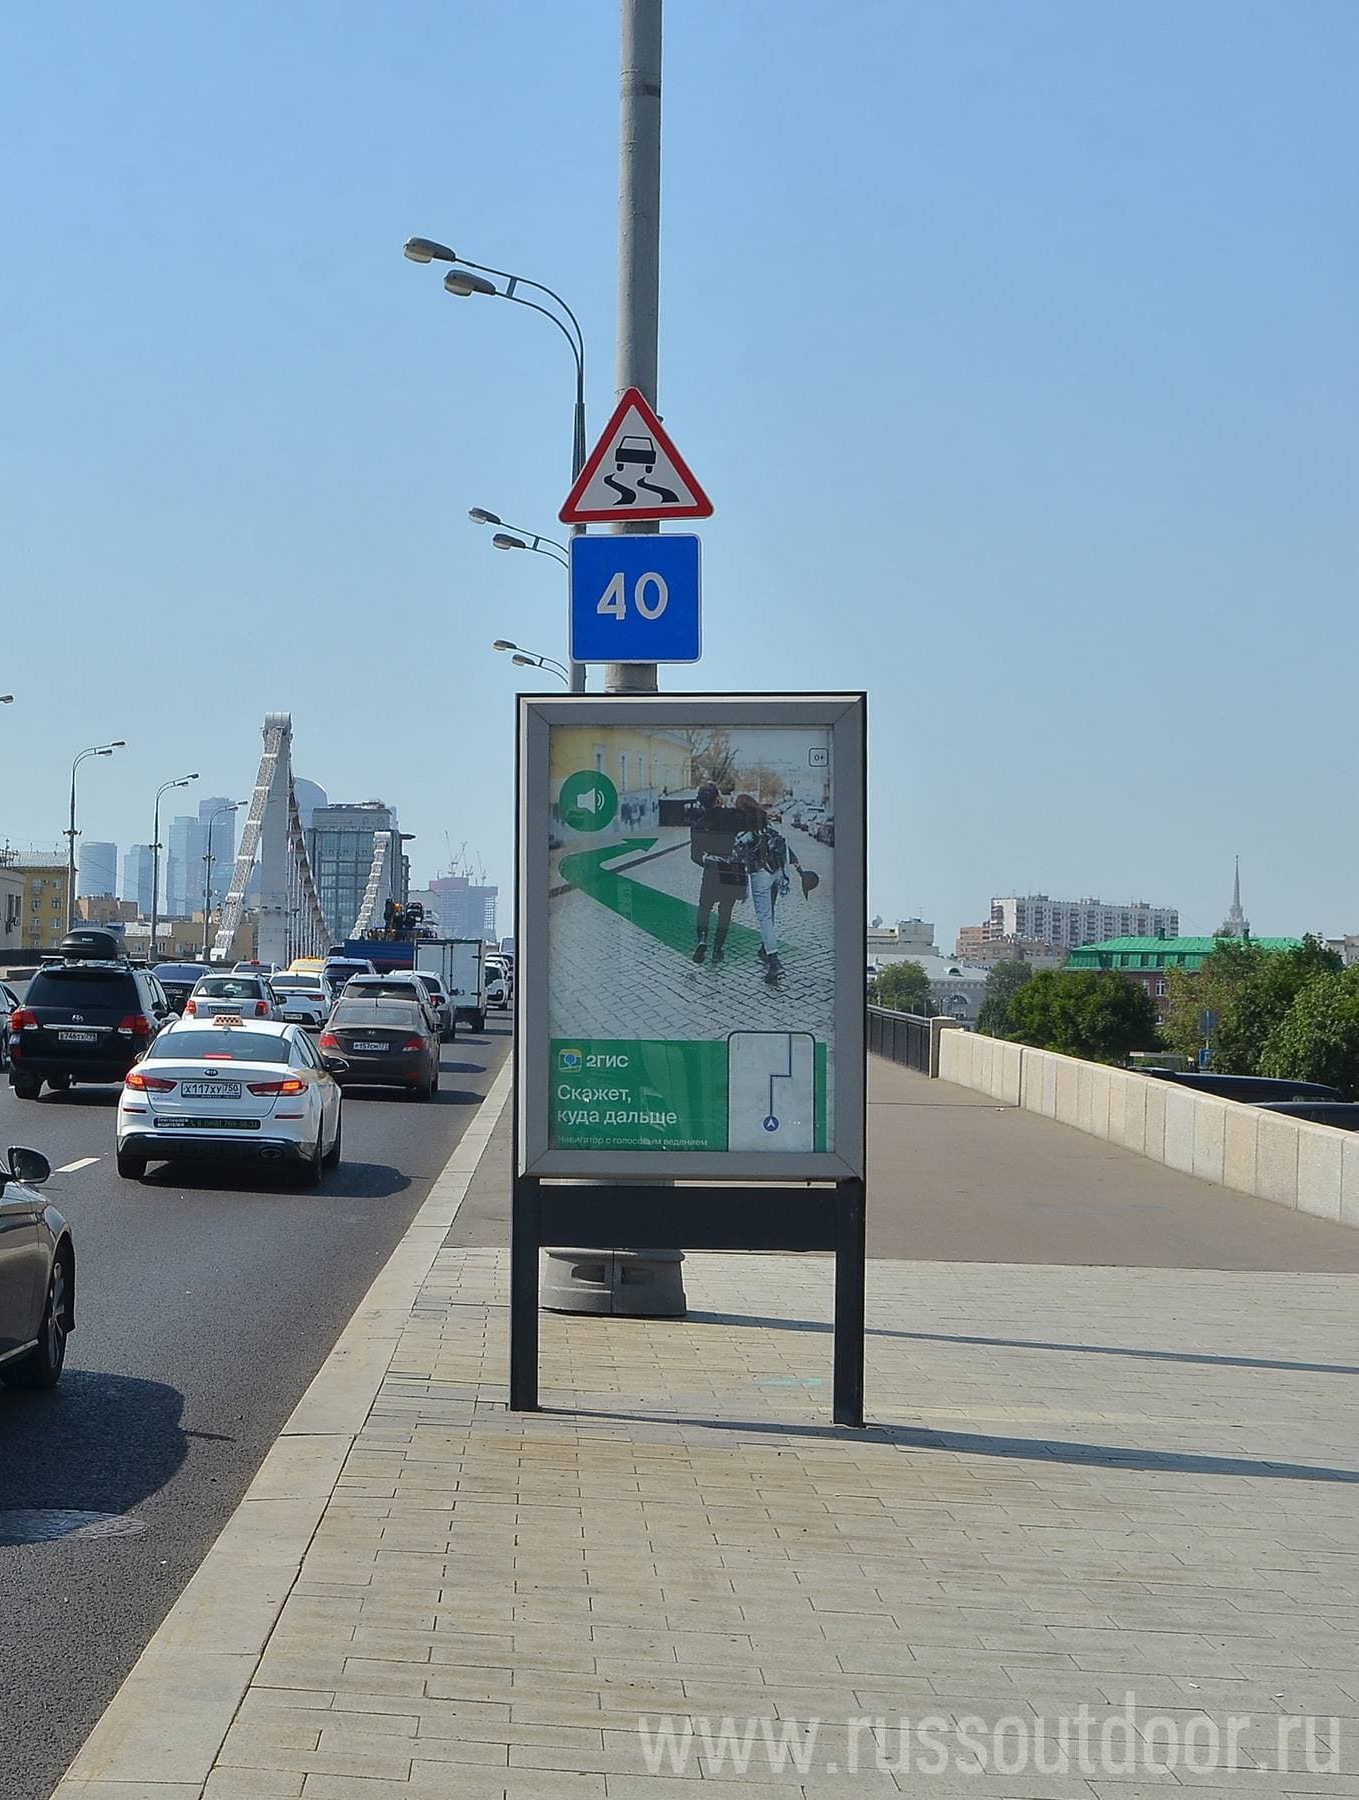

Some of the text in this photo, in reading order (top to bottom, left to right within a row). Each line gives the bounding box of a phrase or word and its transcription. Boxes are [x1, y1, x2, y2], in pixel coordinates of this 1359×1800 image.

[597, 571, 669, 621] 40
[586, 1055, 629, 1068] 2ГИС
[557, 1084, 631, 1104] Скажет,
[557, 1110, 600, 1125] куда
